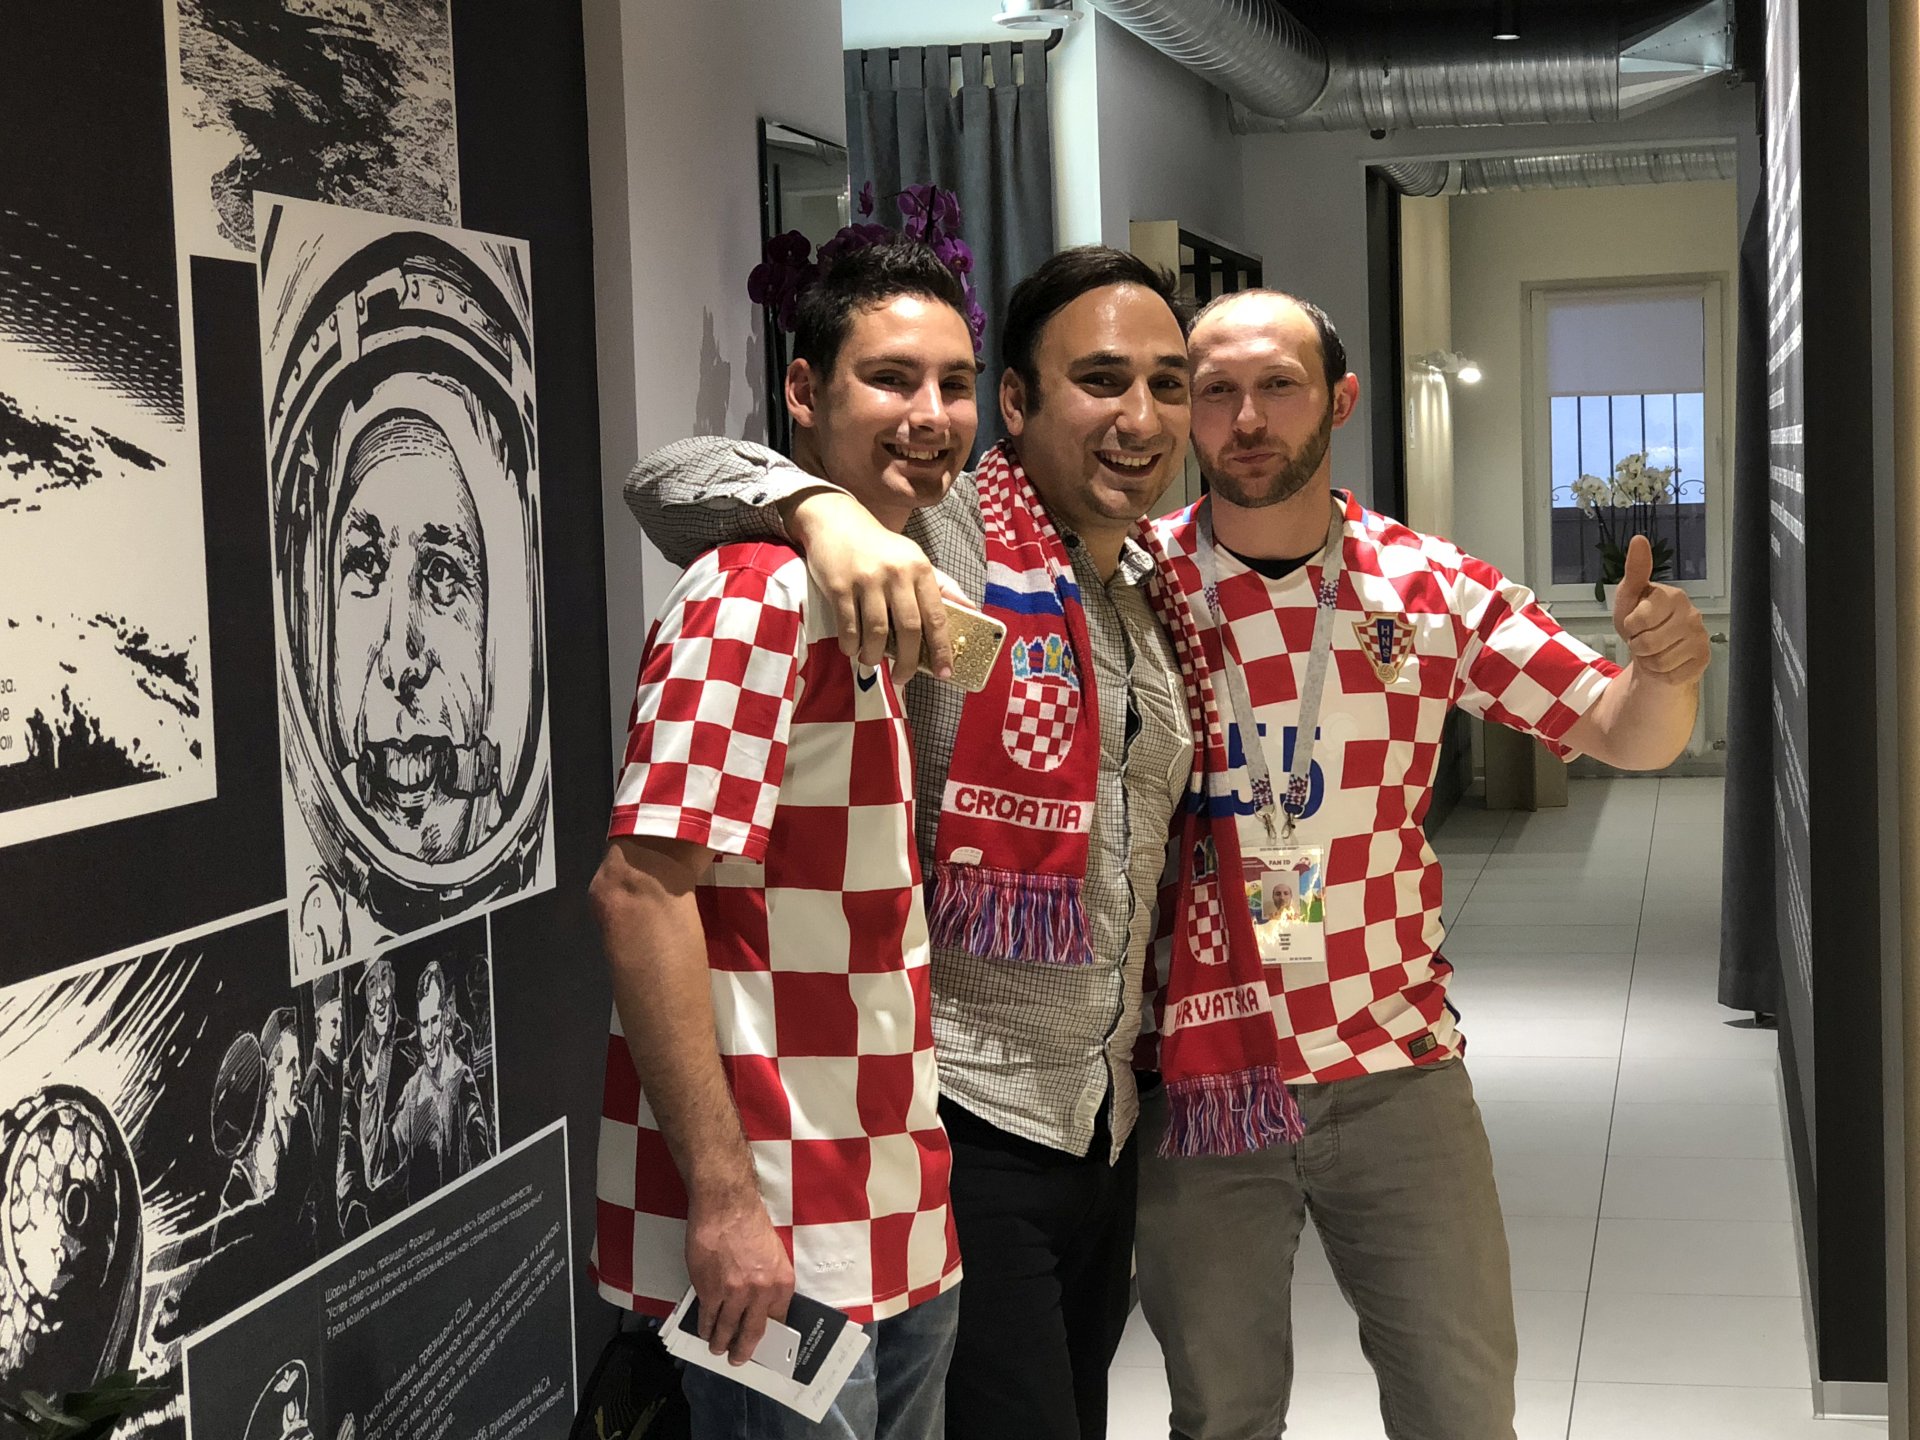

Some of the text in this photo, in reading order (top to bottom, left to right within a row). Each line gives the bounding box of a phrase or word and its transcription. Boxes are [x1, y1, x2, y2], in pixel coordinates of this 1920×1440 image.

[1380, 624, 1391, 658] HNS
[955, 787, 1082, 829] CROATIA
[325, 1283, 348, 1303] Шарль
[348, 1275, 357, 1289] де
[376, 1243, 408, 1271] президент
[408, 1227, 436, 1250] Франции
[348, 1280, 380, 1307] советских
[401, 1264, 406, 1272] и
[477, 1205, 496, 1225] Европе
[326, 1326, 332, 1340] Я
[332, 1321, 346, 1339] рад
[380, 1280, 408, 1306] должное
[382, 1396, 409, 1431] самое
[409, 1334, 462, 1402] замечательное
[463, 1302, 489, 1339] научное
[530, 1250, 535, 1261] и
[535, 1245, 539, 1255] я
[395, 1419, 409, 1440] все
[424, 1386, 437, 1408] как
[437, 1366, 456, 1390] часть
[501, 1305, 505, 1317] в
[505, 1273, 530, 1312] высшей
[531, 1248, 555, 1282] степени
[432, 1375, 468, 1425] русскими,
[469, 1339, 496, 1377] которые
[496, 1307, 522, 1344] приняли
[522, 1279, 546, 1317] участие
[546, 1274, 550, 1285] в
[550, 1257, 566, 1280] этом
[363, 1297, 473, 1432] Джон Кеннеди, президент США
[489, 1393, 532, 1439] руководитель
[532, 1375, 551, 1400] НАСА
